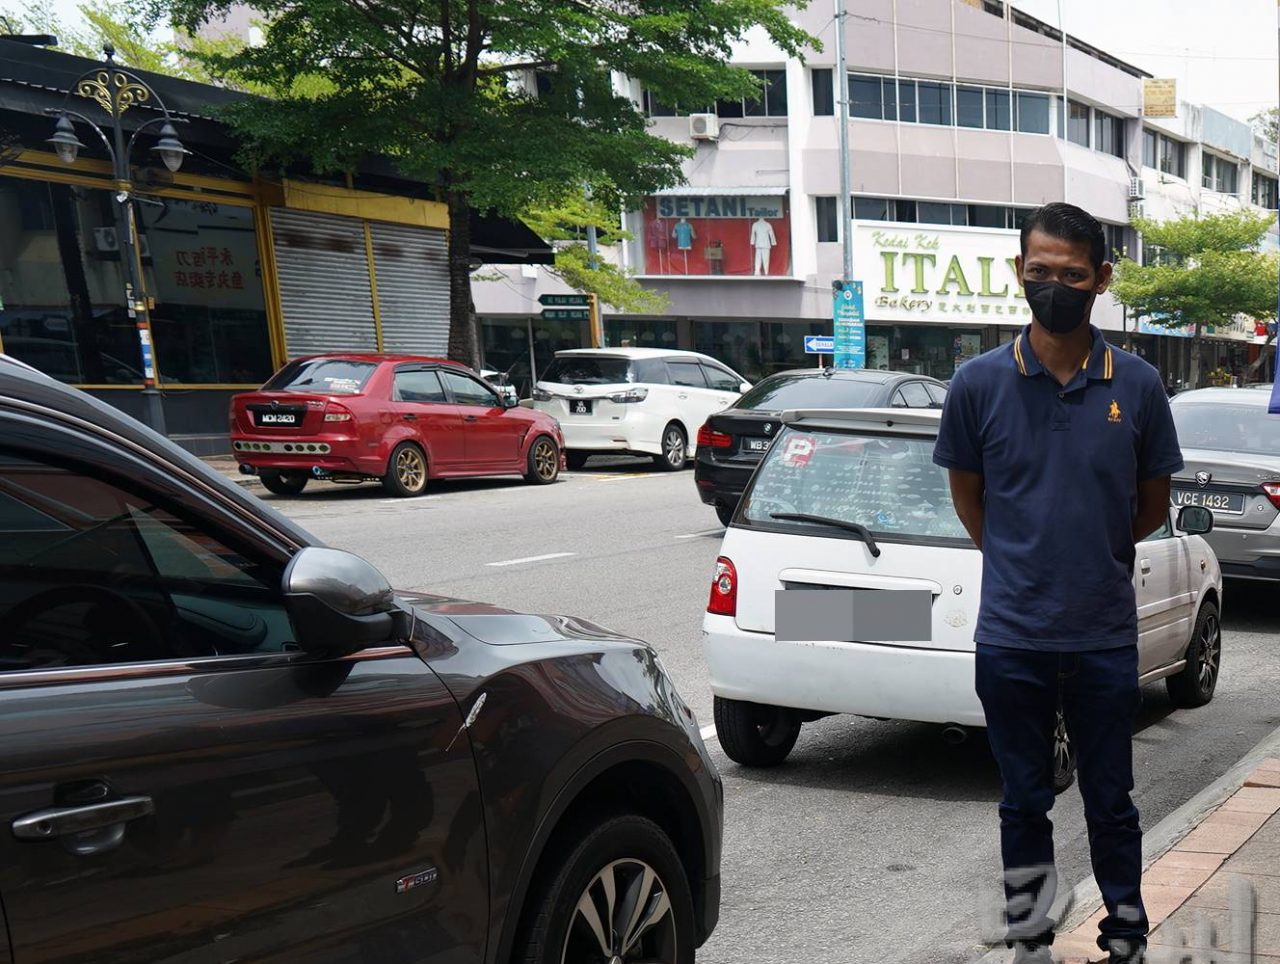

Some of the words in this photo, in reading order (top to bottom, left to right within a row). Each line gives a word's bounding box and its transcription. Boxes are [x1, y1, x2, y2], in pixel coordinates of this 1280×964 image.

[660, 197, 747, 217] SETANI
[747, 207, 778, 217] Tailor
[871, 231, 910, 250] Kedai
[875, 296, 933, 312] Bakery
[1177, 492, 1199, 506] VCE
[1202, 494, 1229, 509] 1432
